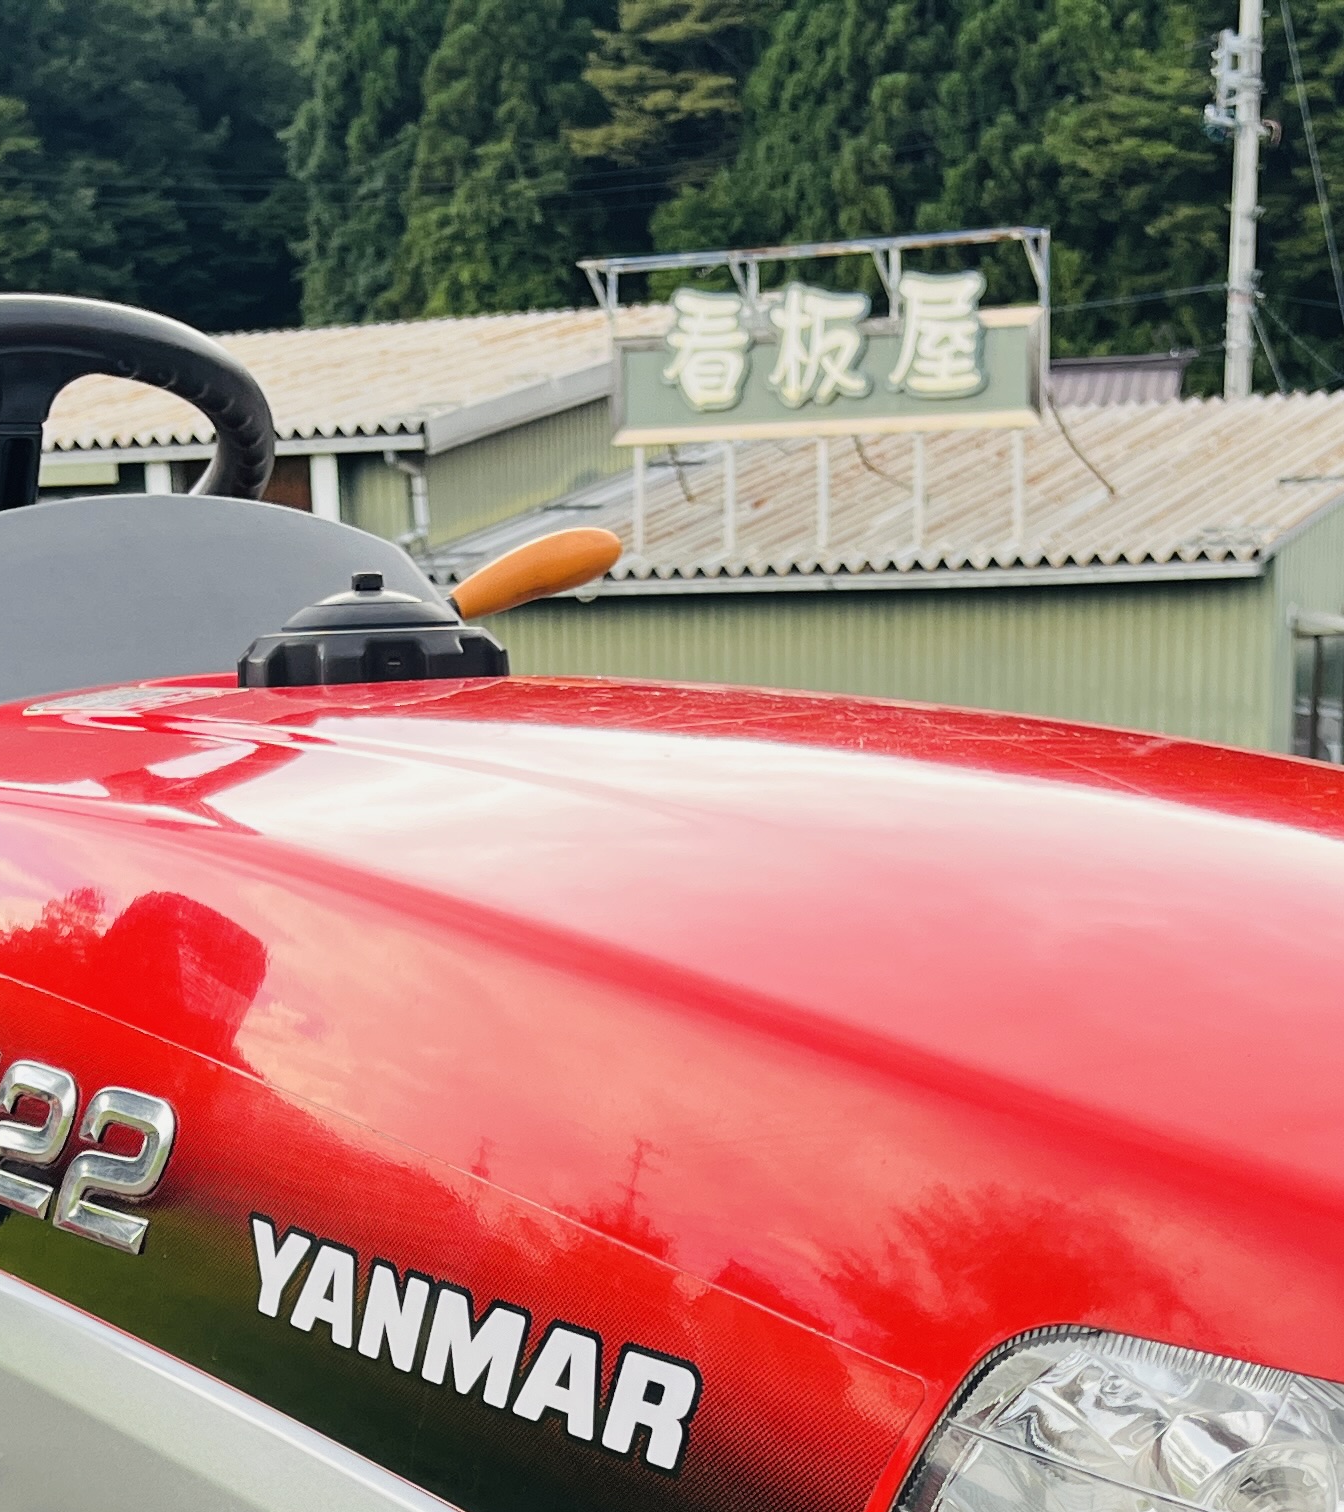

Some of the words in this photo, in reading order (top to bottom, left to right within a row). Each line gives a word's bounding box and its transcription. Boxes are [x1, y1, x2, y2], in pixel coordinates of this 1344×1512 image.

[663, 272, 986, 411] 看板屋
[250, 1216, 698, 1472] YANMAR
